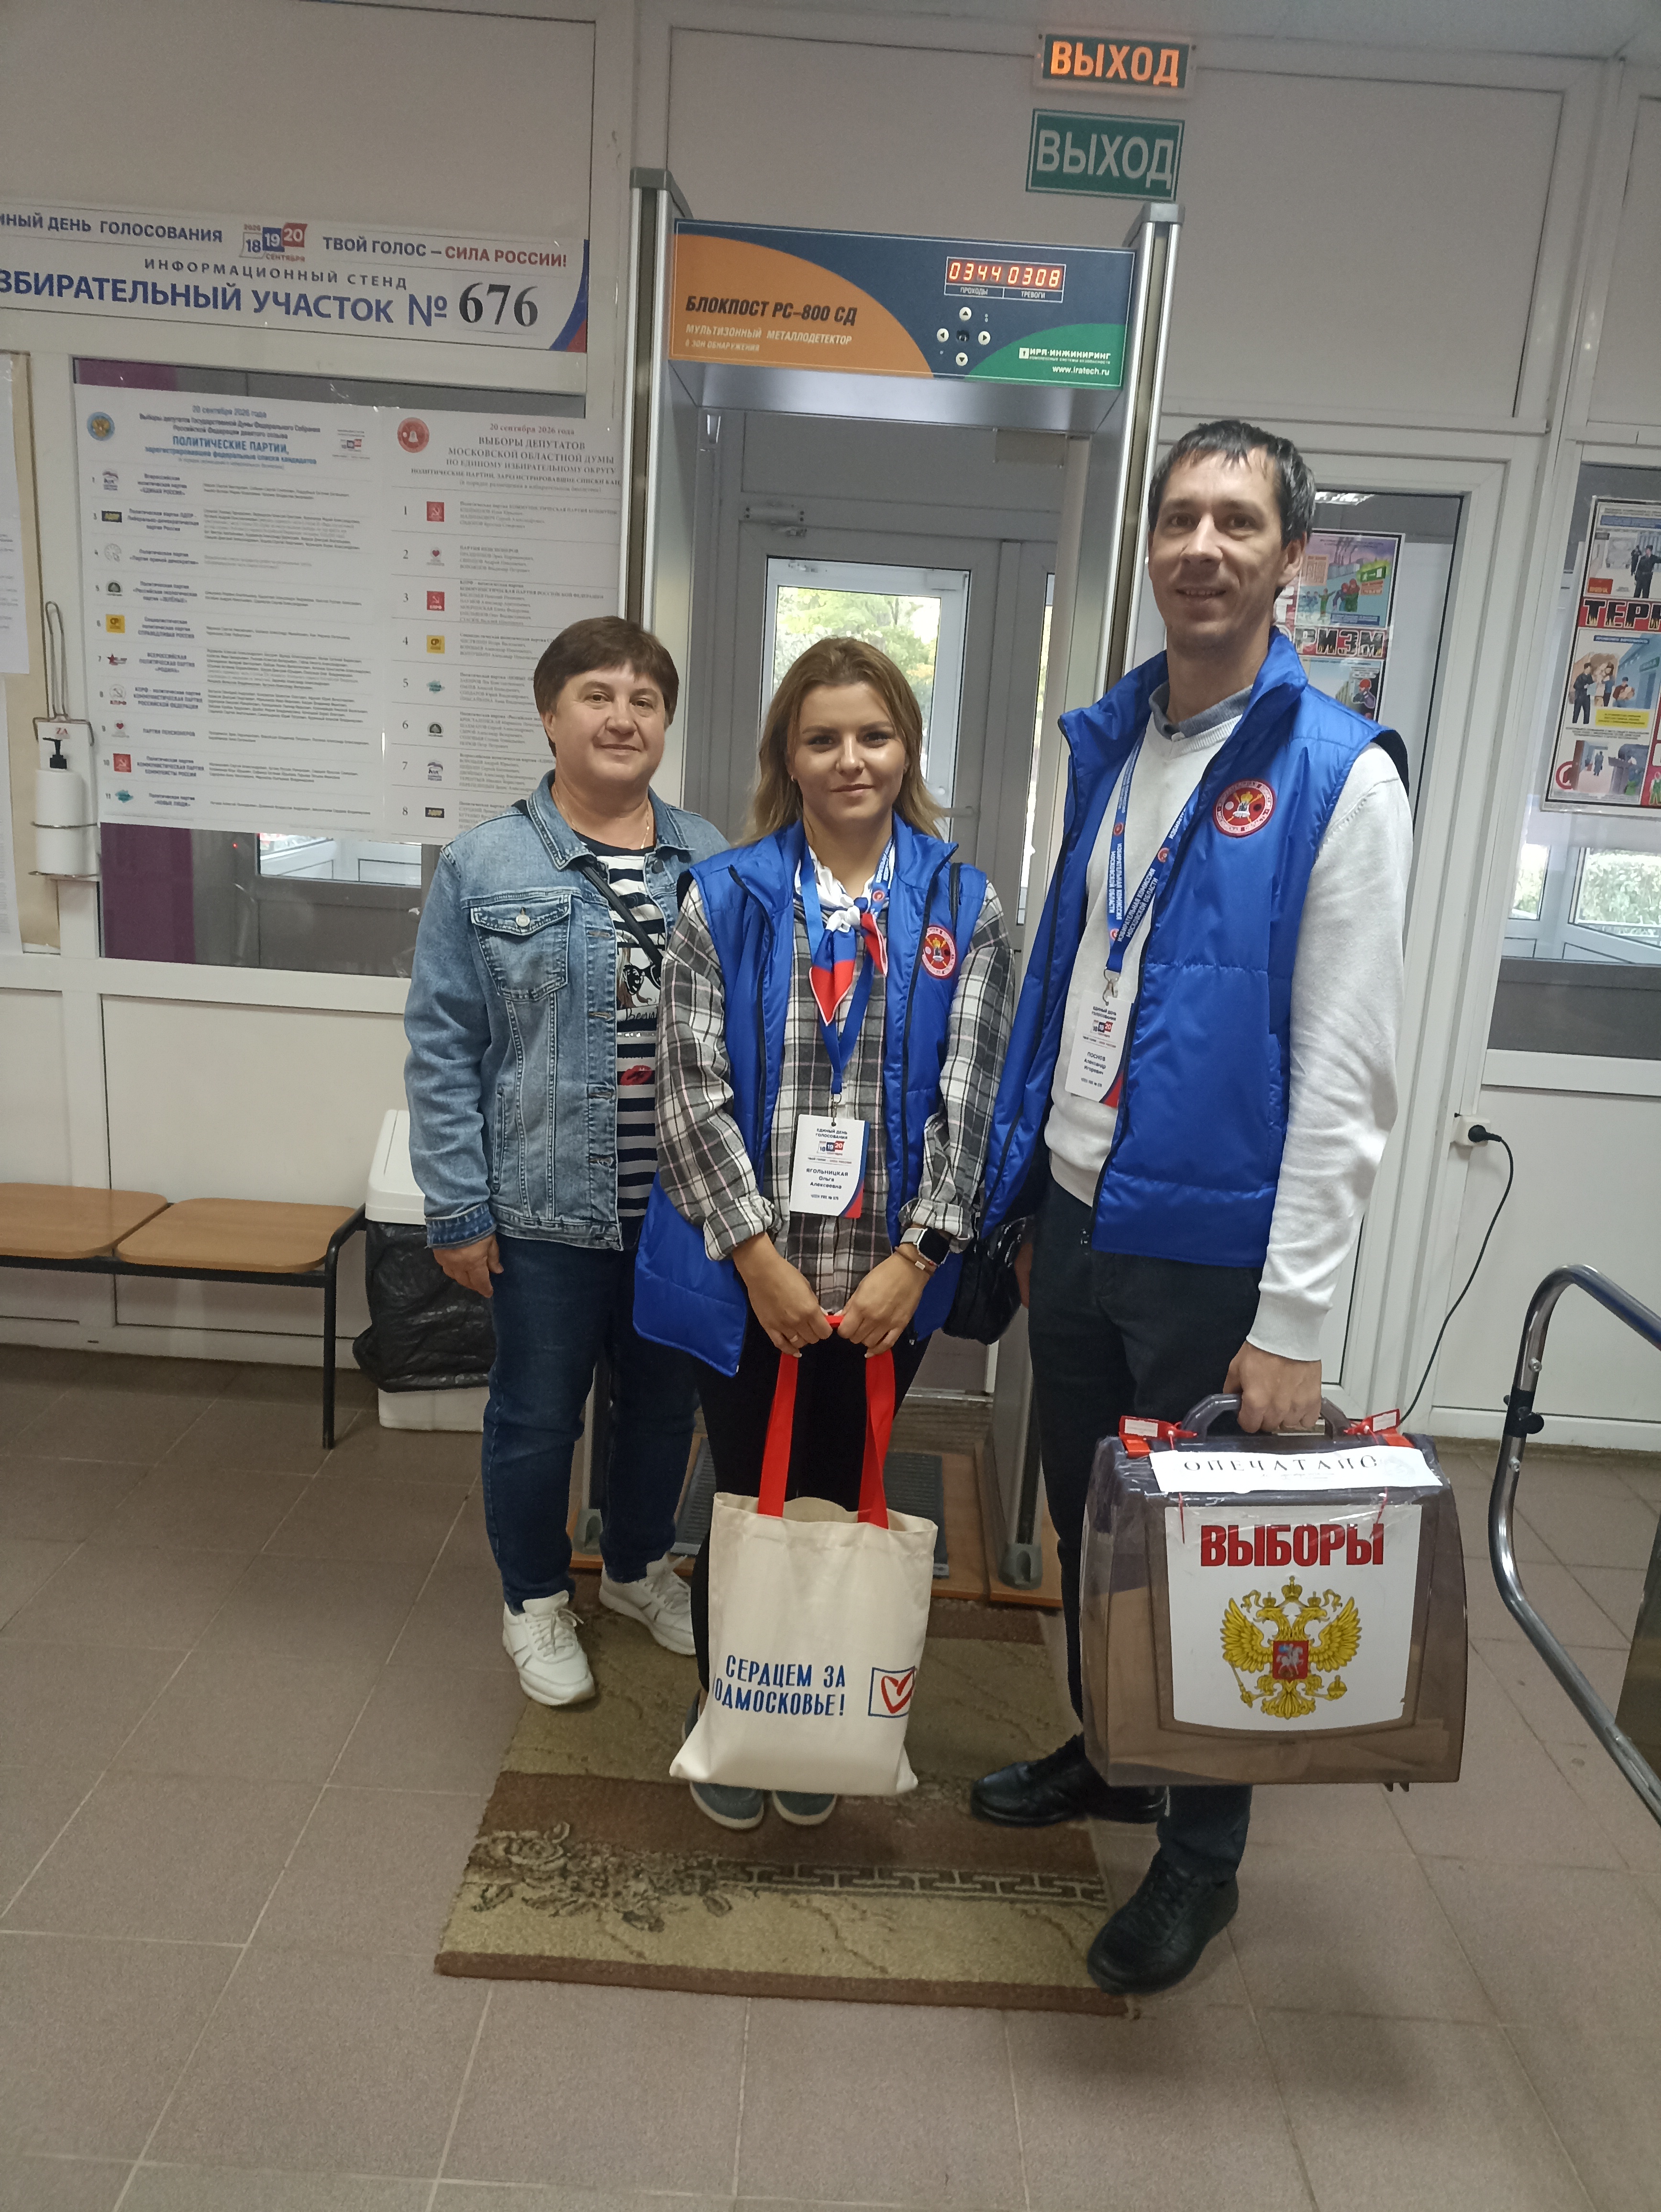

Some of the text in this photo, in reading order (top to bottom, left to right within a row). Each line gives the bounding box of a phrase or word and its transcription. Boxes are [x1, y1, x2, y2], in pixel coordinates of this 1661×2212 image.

[1051, 40, 1179, 88] ВЫХОД
[1037, 130, 1174, 189] ВЫХОД
[48, 216, 91, 232] ДЕНЬ
[100, 220, 223, 243] ГОЛОСОВАНИЯ
[246, 228, 303, 253] 18 19 20
[266, 253, 305, 262] СЕНТЯБРЯ
[323, 236, 367, 252] ТВОЙ
[372, 240, 426, 257] ГОЛОС
[445, 246, 490, 262] СИЛА
[495, 249, 567, 267] РОССИИ!
[144, 258, 407, 290] ИНФОРМАЦИОННЫЙ СТЕНД
[949, 262, 1060, 288] 0344 0308
[960, 287, 1045, 299] ПРОХОДЫ ТРЕВОГИ
[252, 289, 394, 324] УЧАСТОК
[409, 294, 448, 327] №
[459, 282, 538, 327] 676
[686, 296, 770, 317] БЛОКПОСТ
[834, 306, 858, 326] СД
[686, 324, 852, 345] МУЛЬТИЗОННЫЙ МЕТАЛЛОДЕТЕКТОР
[691, 340, 705, 348] ЗОН
[707, 341, 760, 352] ОБНАРУЖЕНИЯ
[1052, 366, 1109, 376] www.iratech.ru
[500, 425, 535, 434] сентября
[173, 435, 289, 454] ПОЛИТИЧЕСКИЕ ПАРТИИ,
[478, 436, 586, 450] ВЫБОРЫ ДЕПУТАТОВ
[448, 447, 614, 465] МОСКОВСКОЙ ОБЛАСТНОЙ ДУМЫ
[411, 468, 465, 476] ПОЛИТИЧЕСКИЕ
[461, 460, 501, 468] ЕДИНОМУ
[505, 462, 581, 473] ИЗБИРАТЕЛЬНОМУ
[404, 506, 407, 515] 1
[403, 549, 409, 559] 2
[403, 593, 409, 603] 3
[402, 637, 408, 646] 4
[402, 678, 409, 687] 5
[402, 720, 409, 730] 6
[402, 762, 408, 770] 7
[402, 807, 408, 816] 8
[1117, 867, 1156, 942] ИЗБИРАТЕЛЬНАЯ КОМИССИЯ
[1126, 877, 1158, 938] МОСКОВСКОЙ ОБЛАСТИ
[806, 1168, 848, 1176] ЯГОЛЬНИЦКАЯ
[1201, 1523, 1384, 1567] ВЫБОРЫ
[726, 1655, 845, 1688] СЕРДЦЕМ ЗА
[713, 1674, 845, 1716] ОДМОСКОВЬЕ!
